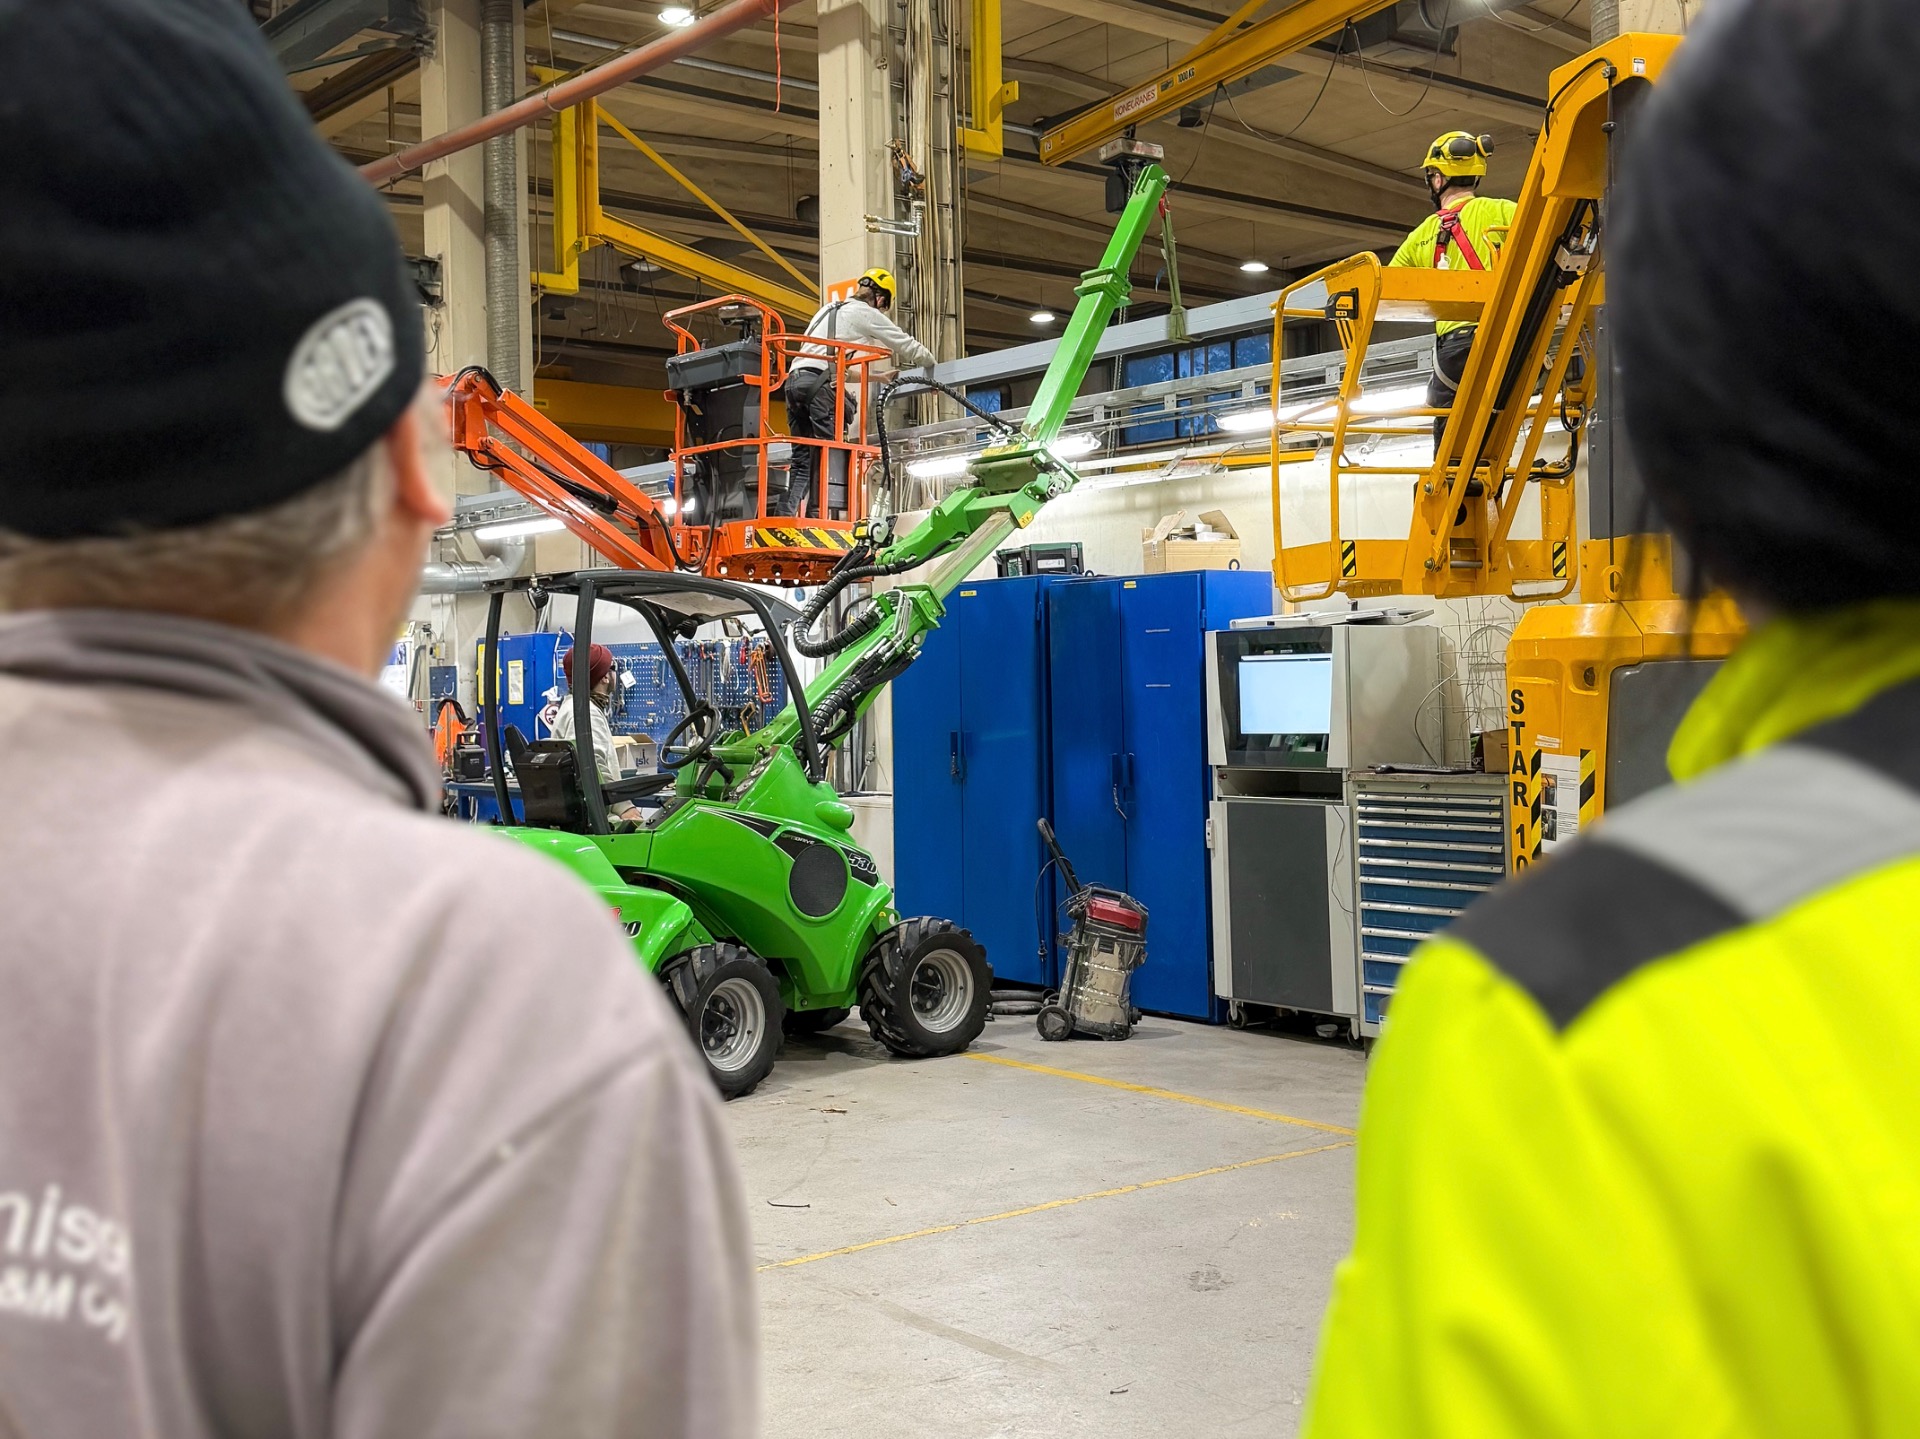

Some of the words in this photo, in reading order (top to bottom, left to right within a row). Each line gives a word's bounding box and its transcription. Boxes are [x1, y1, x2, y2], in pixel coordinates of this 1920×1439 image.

[1114, 89, 1156, 117] KONECRANES
[1510, 689, 1529, 808] STAR
[780, 832, 816, 845] OPTIDRIVE
[848, 852, 878, 875] 530
